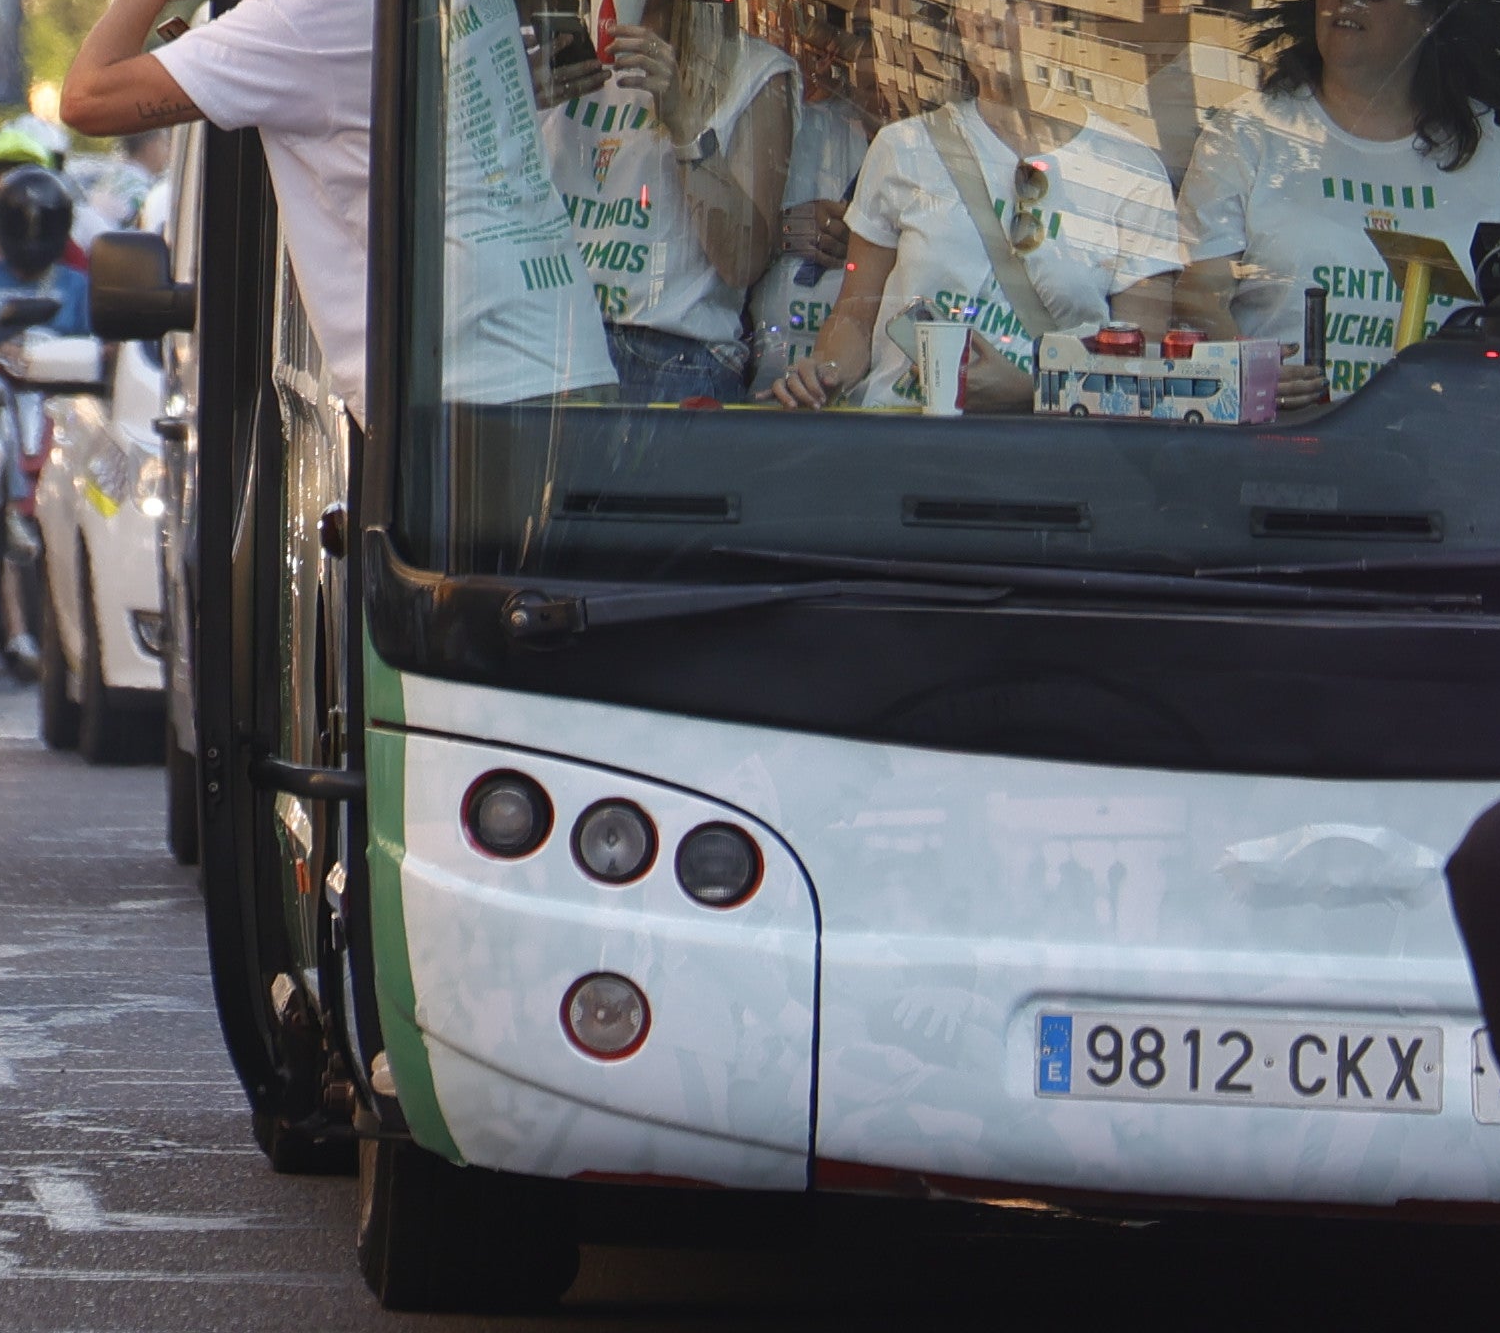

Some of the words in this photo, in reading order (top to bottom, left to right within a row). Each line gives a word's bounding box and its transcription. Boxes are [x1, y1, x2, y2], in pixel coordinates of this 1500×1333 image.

[562, 193, 652, 230] NTIMOS
[1086, 1024, 1255, 1093] 9812
[1288, 1033, 1425, 1102] CKX
